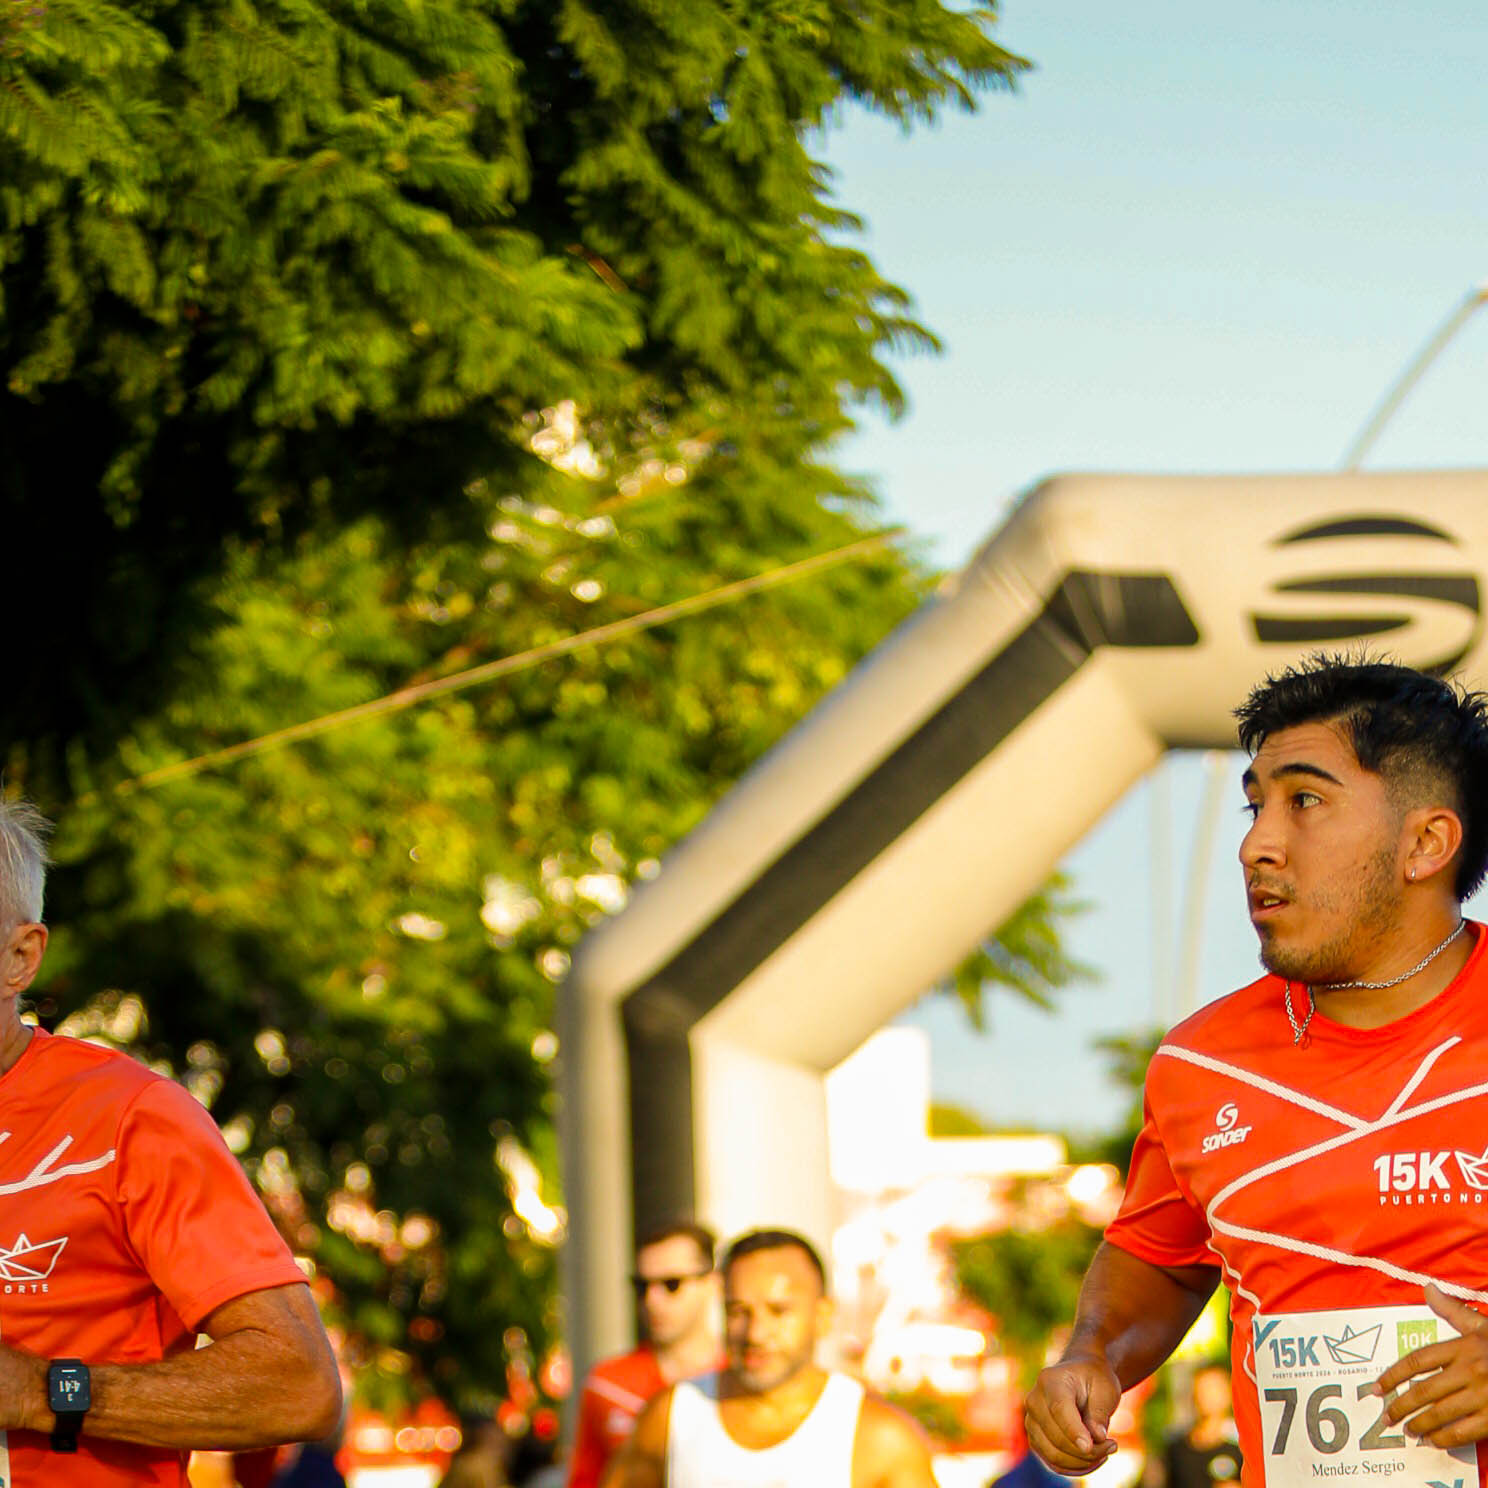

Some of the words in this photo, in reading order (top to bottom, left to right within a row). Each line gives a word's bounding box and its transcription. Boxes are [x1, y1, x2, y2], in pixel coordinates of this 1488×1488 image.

[1373, 1151, 1450, 1192] 15K
[1379, 1193, 1450, 1206] PUERTO
[1269, 1336, 1320, 1368] 15K
[1401, 1332, 1432, 1350] 10K
[1264, 1381, 1428, 1455] 762
[1312, 1464, 1359, 1477] Mendez
[1362, 1460, 1405, 1477] Sergio
